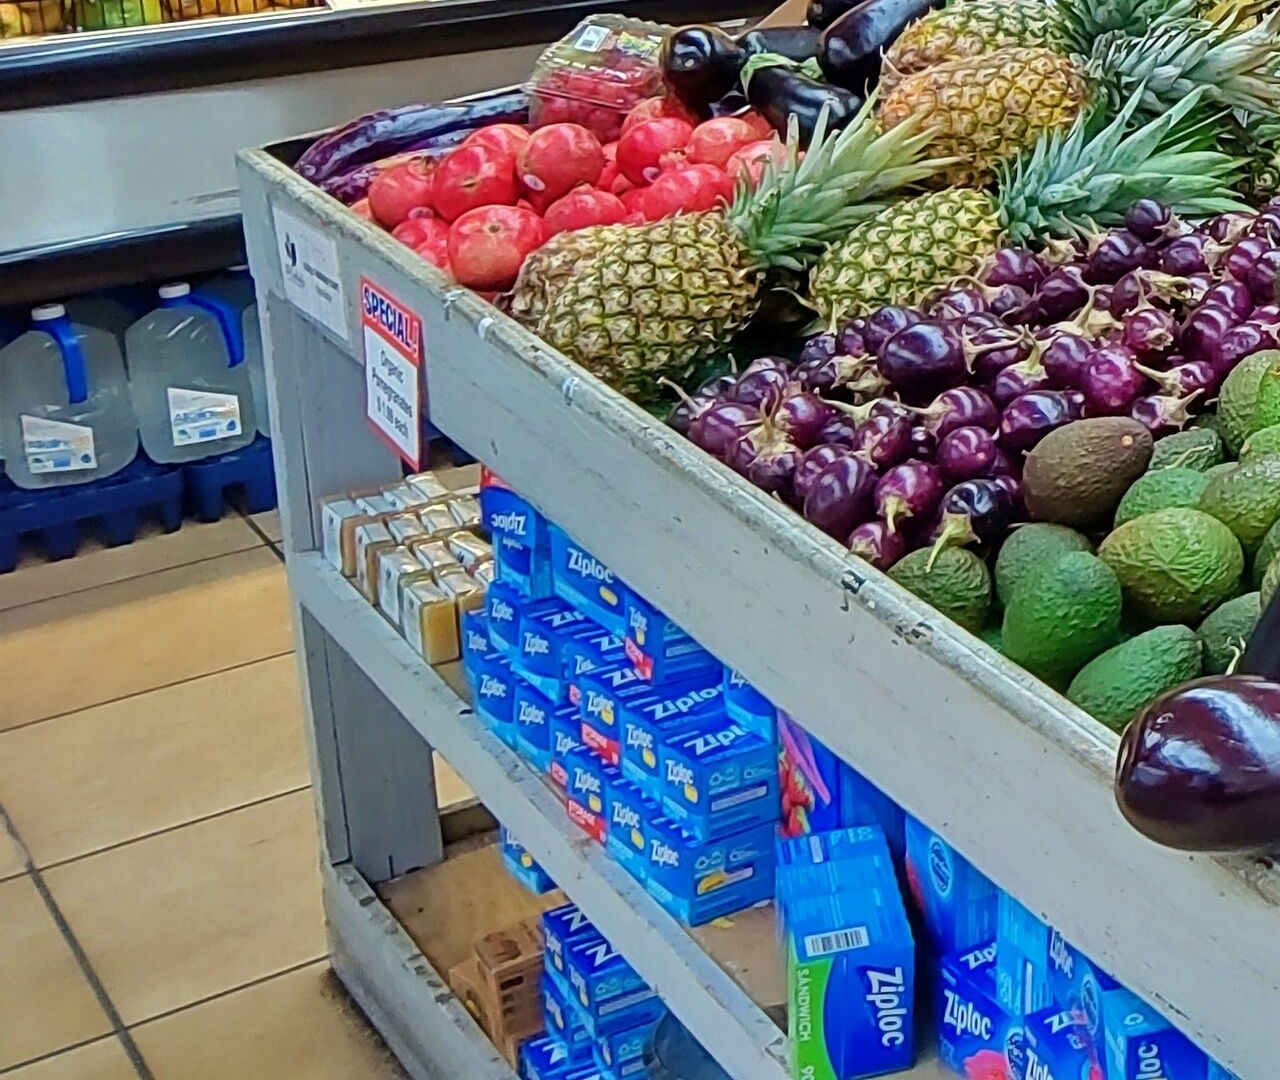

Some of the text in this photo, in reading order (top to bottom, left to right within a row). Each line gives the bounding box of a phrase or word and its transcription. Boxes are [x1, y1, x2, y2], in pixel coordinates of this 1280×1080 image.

[363, 286, 419, 356] SPECIAL!
[491, 511, 527, 535] Ziploc
[566, 547, 615, 584] Ziploc
[683, 724, 748, 756] Zipl
[798, 968, 812, 1041] SANDWICH
[866, 966, 908, 1048] Ziploc
[943, 989, 992, 1040] Ziploc
